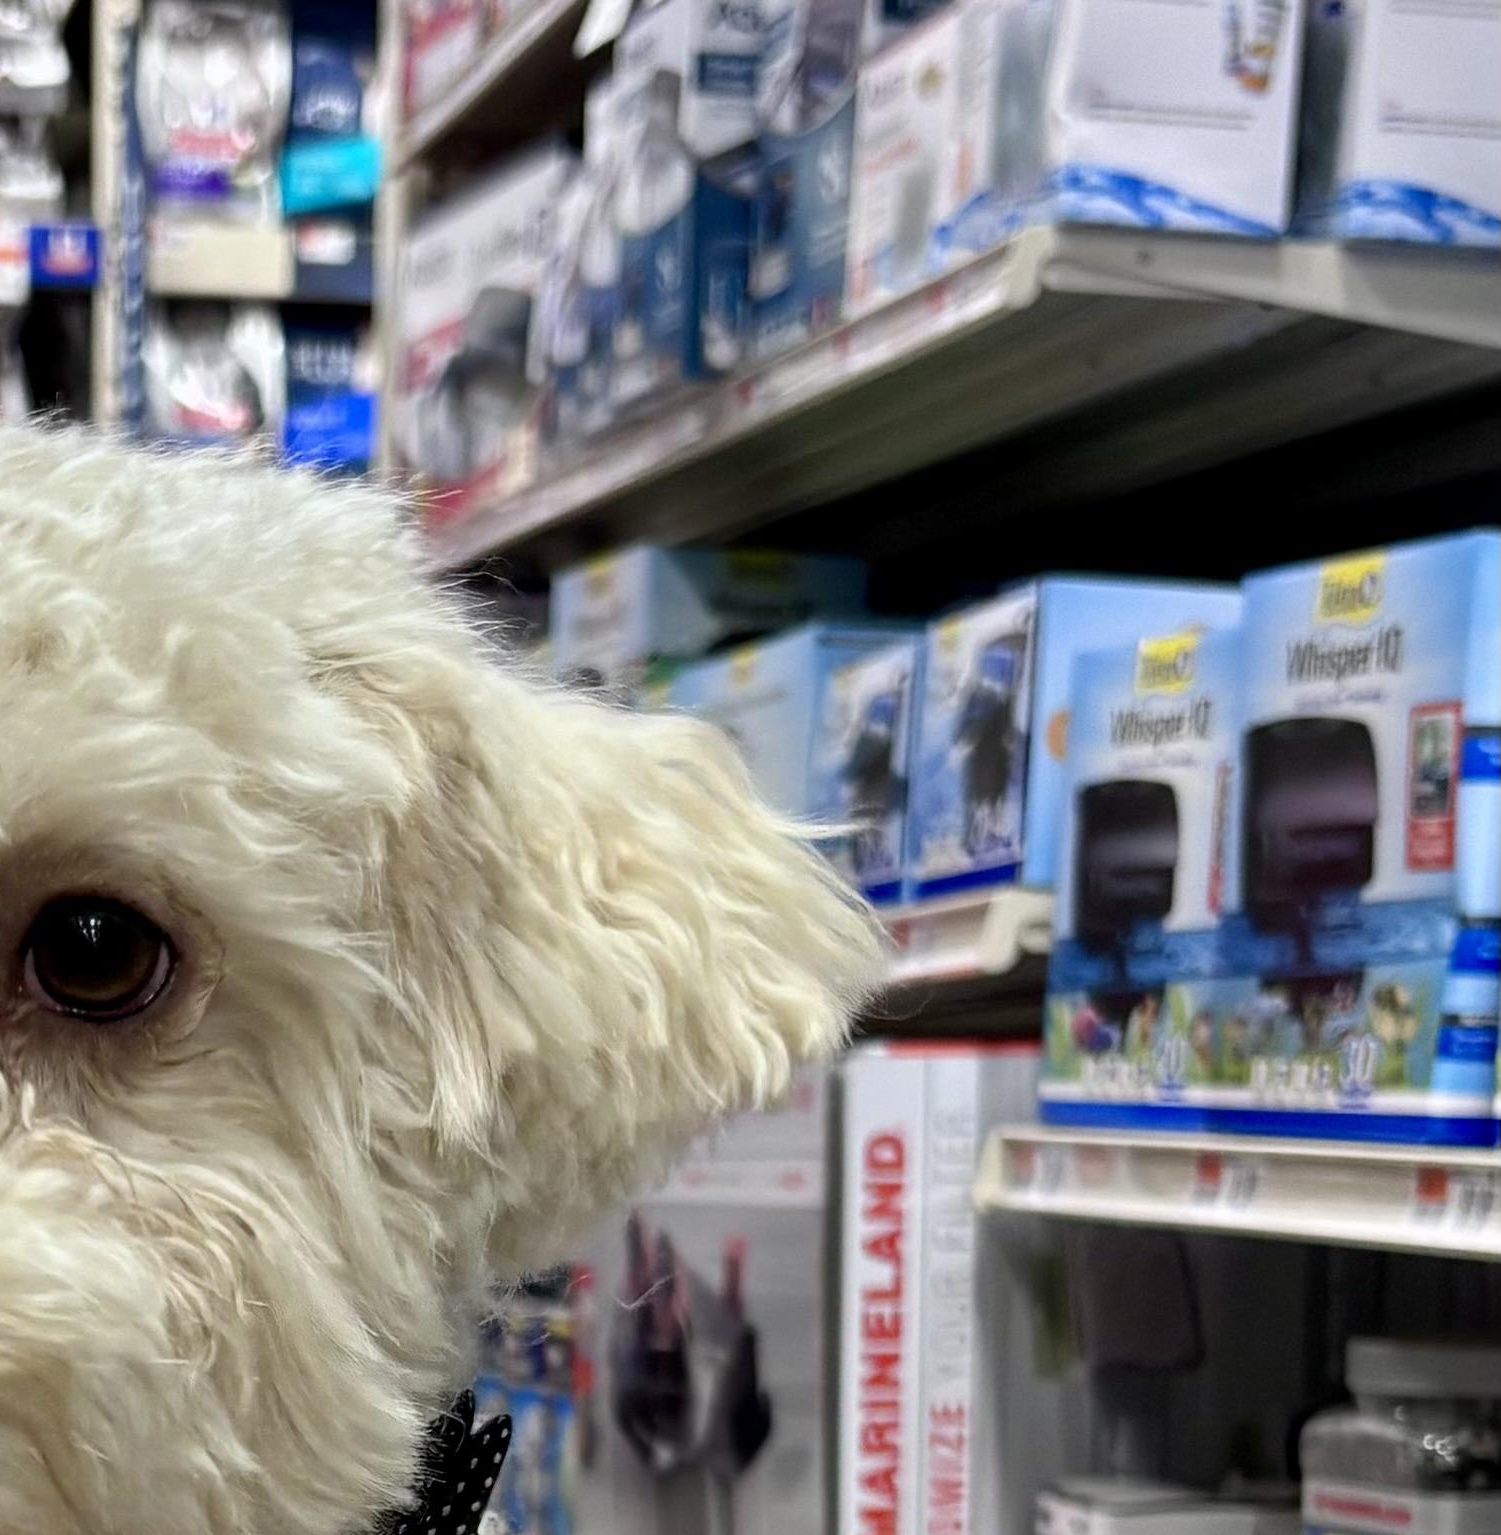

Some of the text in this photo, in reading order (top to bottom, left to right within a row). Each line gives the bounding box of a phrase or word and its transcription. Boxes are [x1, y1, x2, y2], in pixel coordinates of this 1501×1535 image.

[1288, 622, 1404, 685] Whisper IQ
[1114, 708, 1186, 748] Whisper
